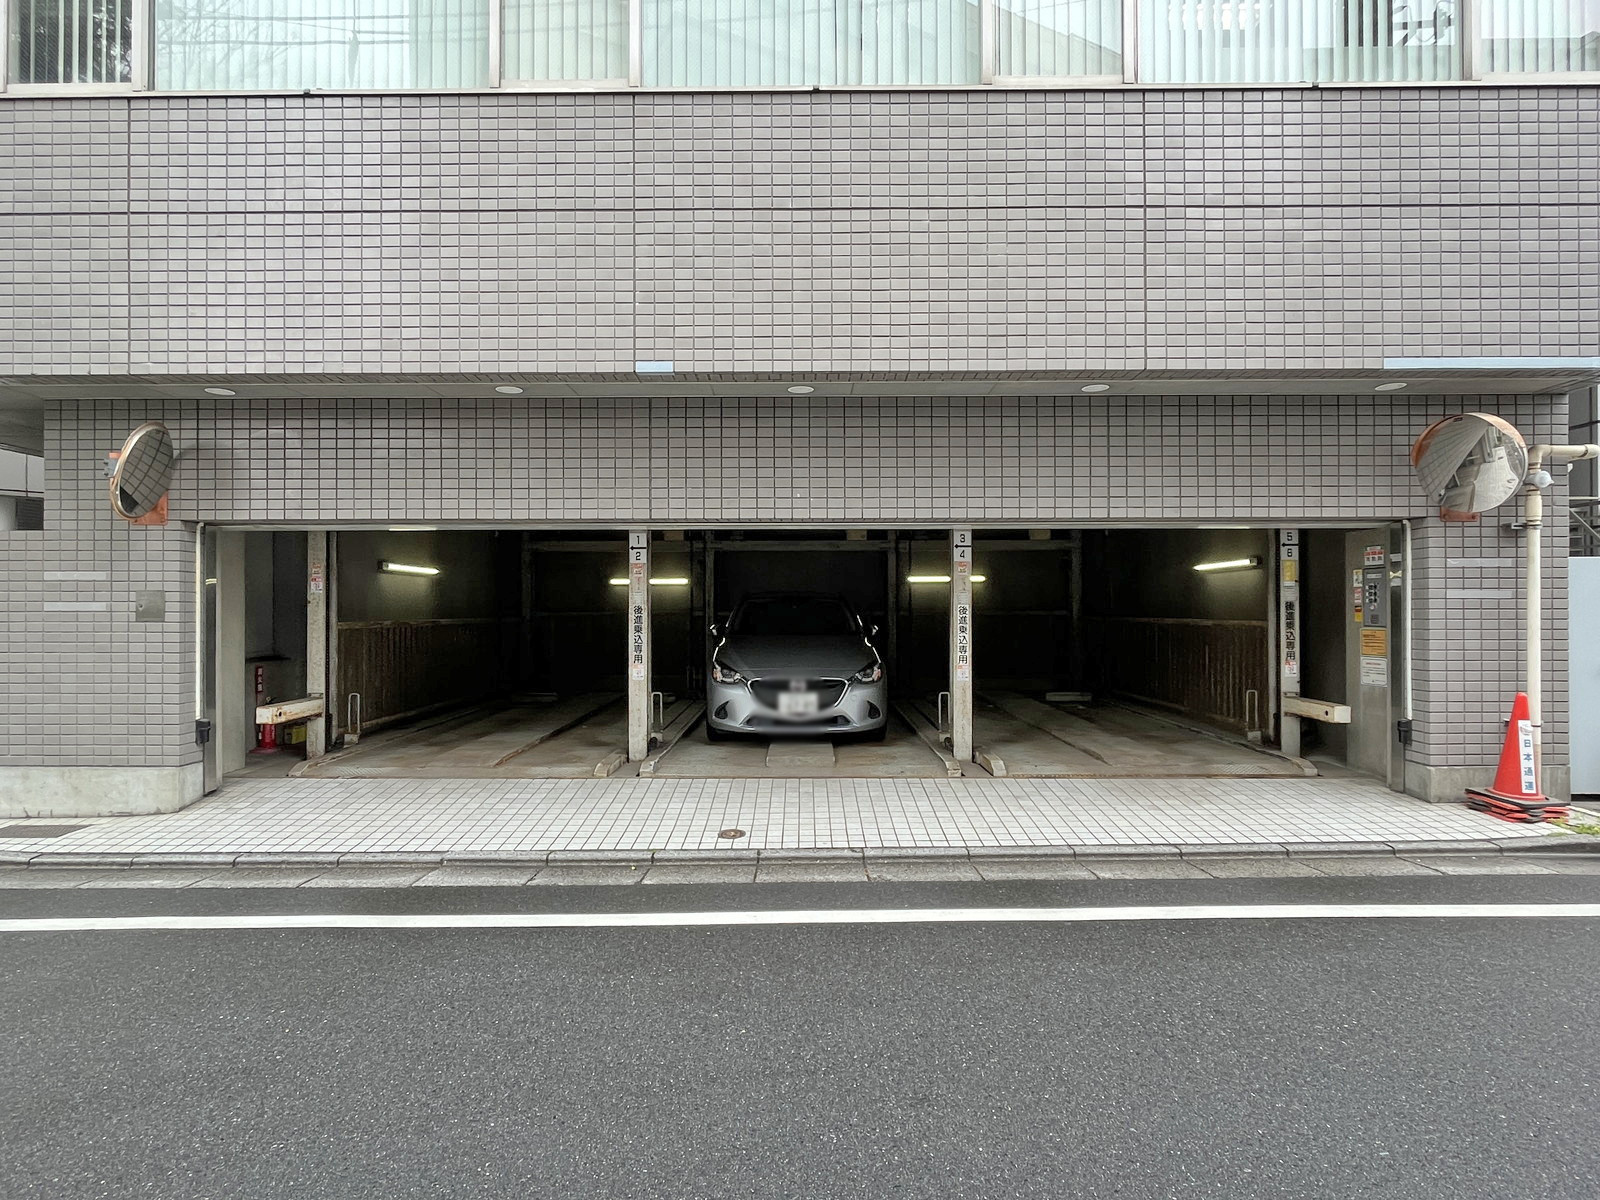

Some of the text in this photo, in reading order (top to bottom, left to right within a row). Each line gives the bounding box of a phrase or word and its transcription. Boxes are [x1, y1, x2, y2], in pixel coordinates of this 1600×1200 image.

[636, 535, 641, 545] 1
[959, 533, 966, 543] 3
[1286, 531, 1293, 541] 5
[635, 551, 642, 561] 2
[959, 550, 966, 559] 4
[1286, 548, 1293, 558] 6
[633, 605, 643, 664] 後進乗込専用
[958, 605, 968, 664] 後進乗込専用
[1284, 601, 1296, 661] 後進乗込専用
